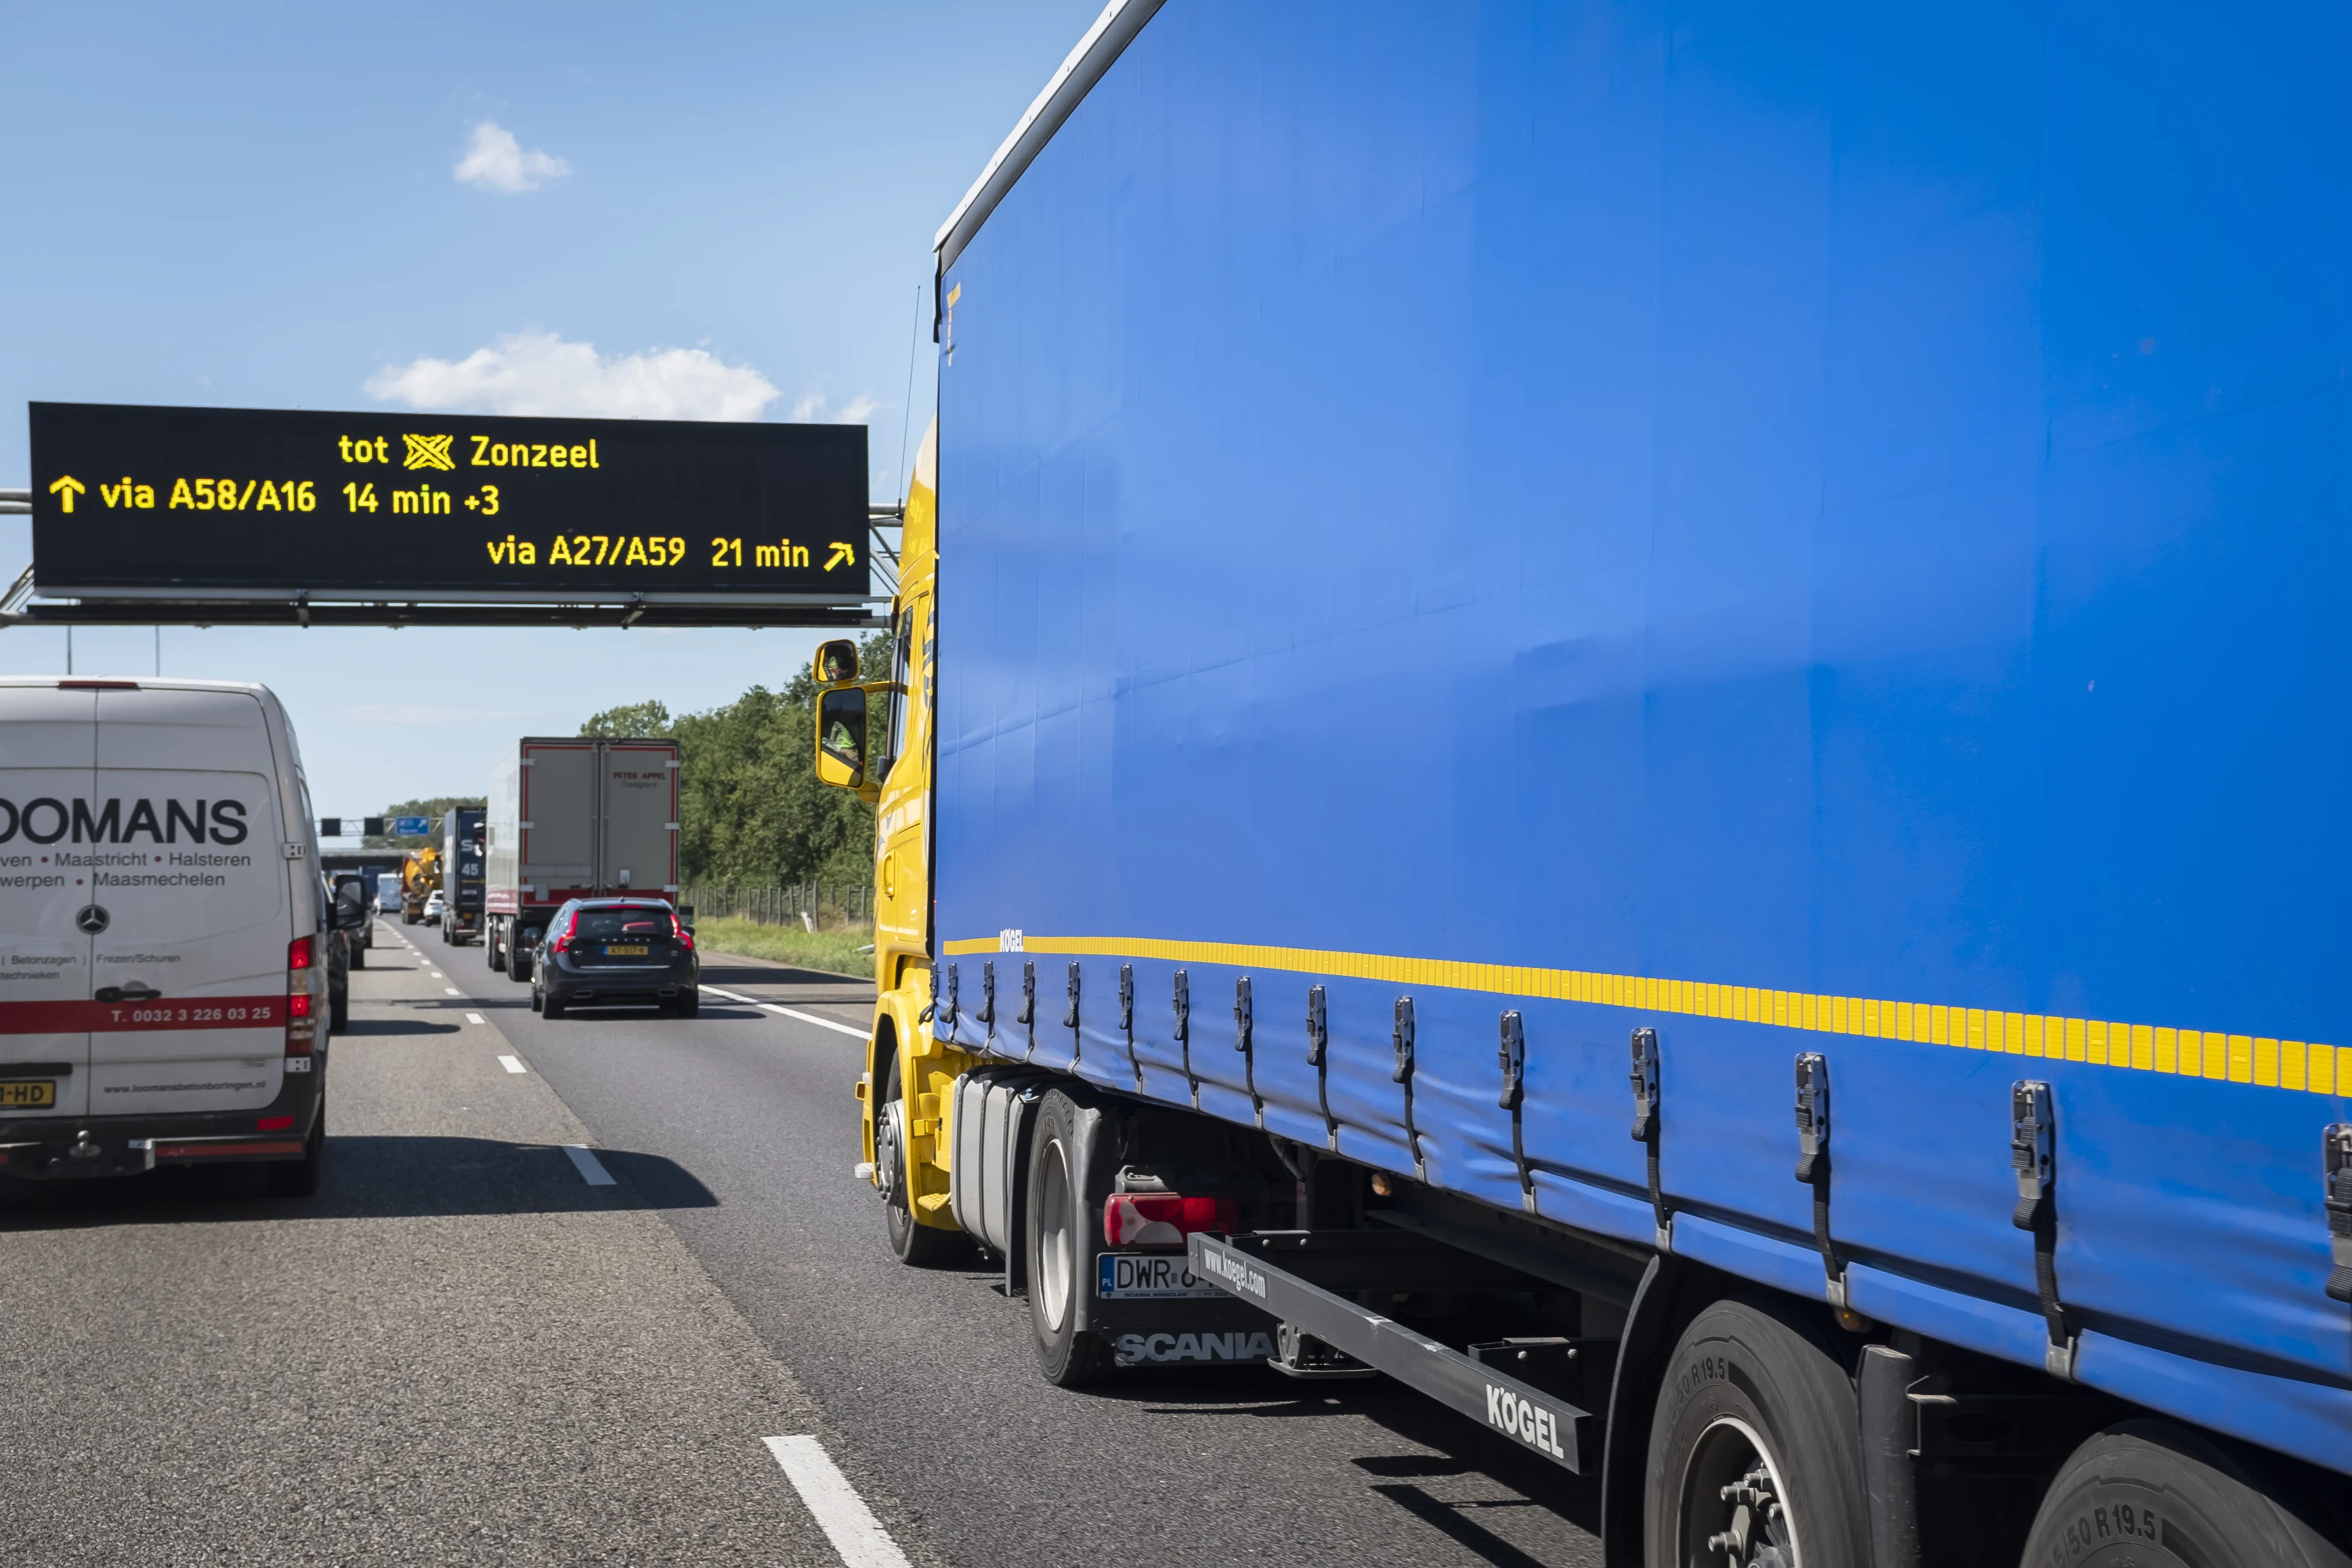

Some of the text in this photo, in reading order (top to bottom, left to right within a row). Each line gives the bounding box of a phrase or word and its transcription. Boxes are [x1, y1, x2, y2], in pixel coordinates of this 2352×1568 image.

[339, 435, 599, 468] tot Zonzeel
[100, 477, 499, 515] via A58/A16 14 min +3
[487, 535, 809, 567] via A27/A59 21 min
[55, 852, 147, 867] Maastricht
[169, 853, 251, 867] Halsteren
[462, 863, 479, 876] 45
[93, 872, 225, 886] Maasmechelen
[1000, 928, 1023, 953] KÖGEL
[12, 956, 77, 967] Betonzagen
[111, 1007, 271, 1022] T. 0032 3 226 03 25
[1117, 1259, 1170, 1289] DWR
[1204, 1248, 1265, 1298] www.koegel.com
[1117, 1333, 1276, 1362] SCANIA
[1691, 1363, 1700, 1387] R
[1701, 1357, 1725, 1380] 19.5
[1486, 1383, 1564, 1458] KÖGEL
[2094, 1507, 2111, 1538] R
[2112, 1504, 2156, 1542] 19.5
